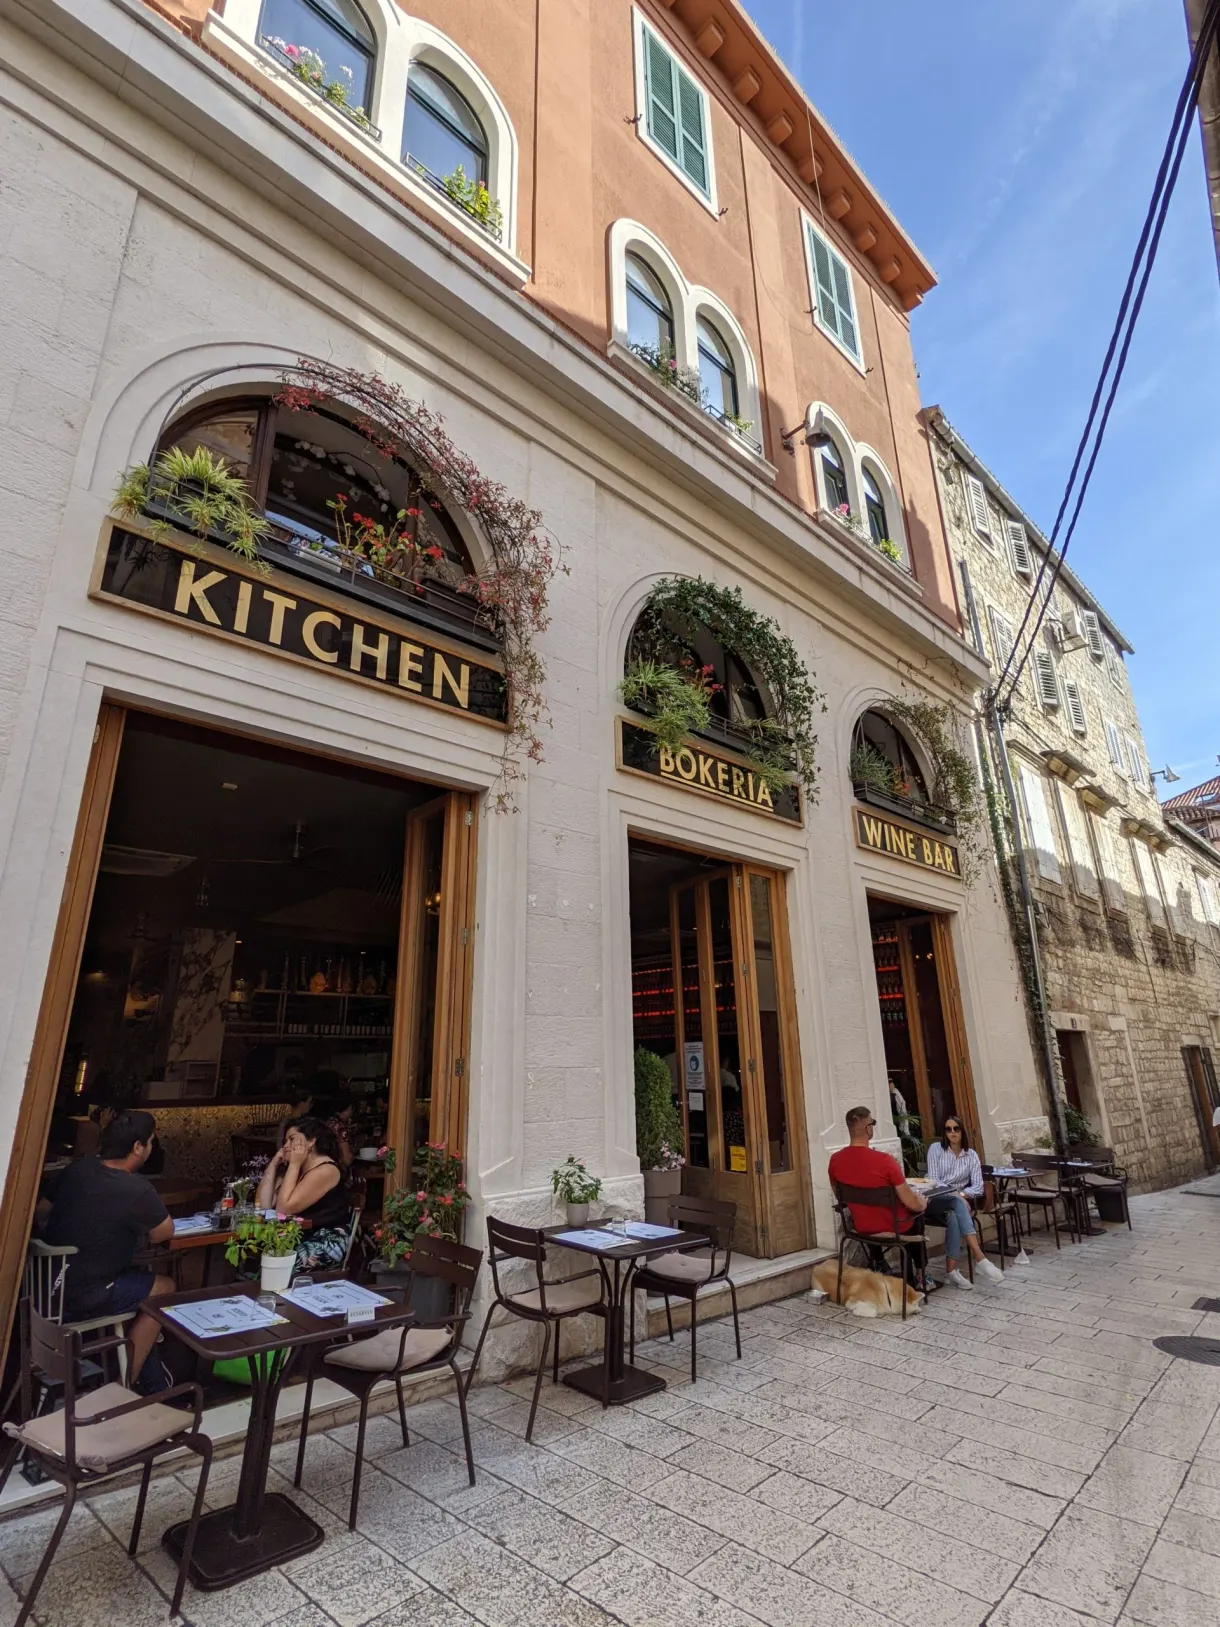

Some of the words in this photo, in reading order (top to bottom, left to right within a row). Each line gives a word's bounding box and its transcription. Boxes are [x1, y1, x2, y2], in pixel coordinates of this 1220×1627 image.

[174, 560, 470, 709] KITCHEN
[659, 747, 774, 808] BOKERIA
[862, 815, 917, 860] WINE
[922, 838, 955, 873] BAR
